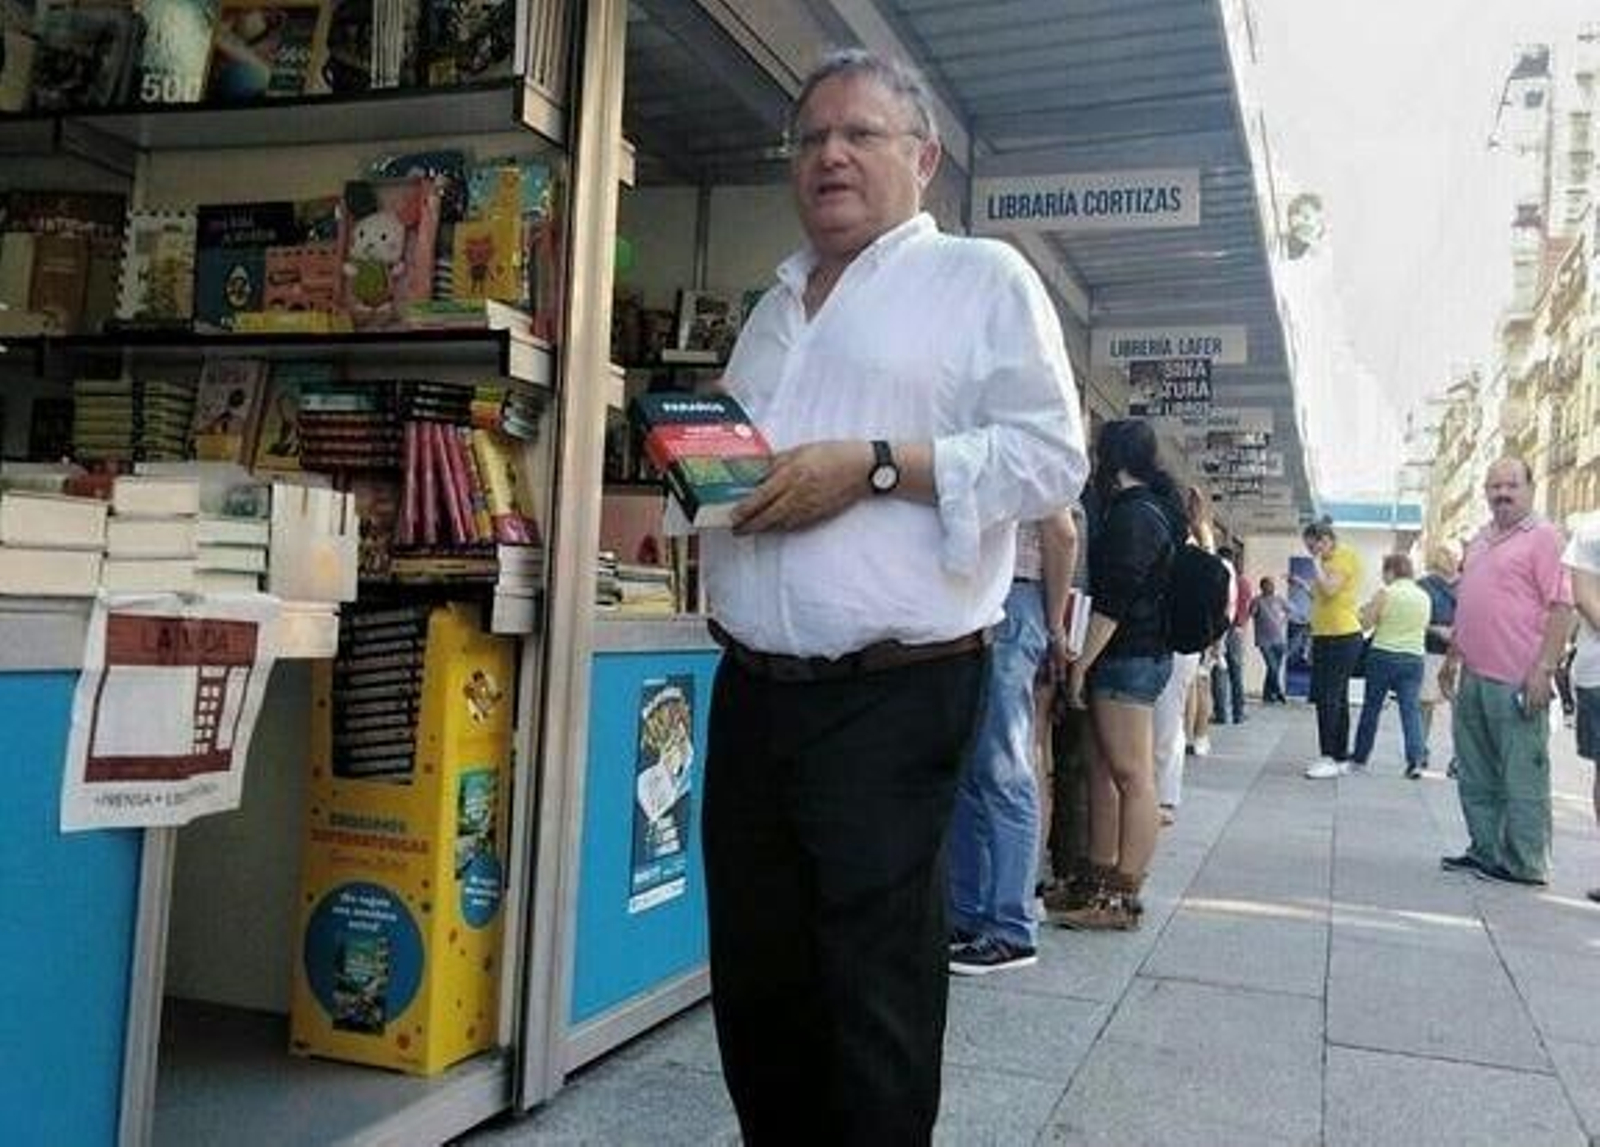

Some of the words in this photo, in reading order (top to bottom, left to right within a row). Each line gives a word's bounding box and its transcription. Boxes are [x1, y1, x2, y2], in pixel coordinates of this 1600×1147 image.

[986, 189, 1078, 220] LIBRARÍA
[1082, 186, 1182, 216] CORTIZAS
[1178, 336, 1222, 356] LAFER
